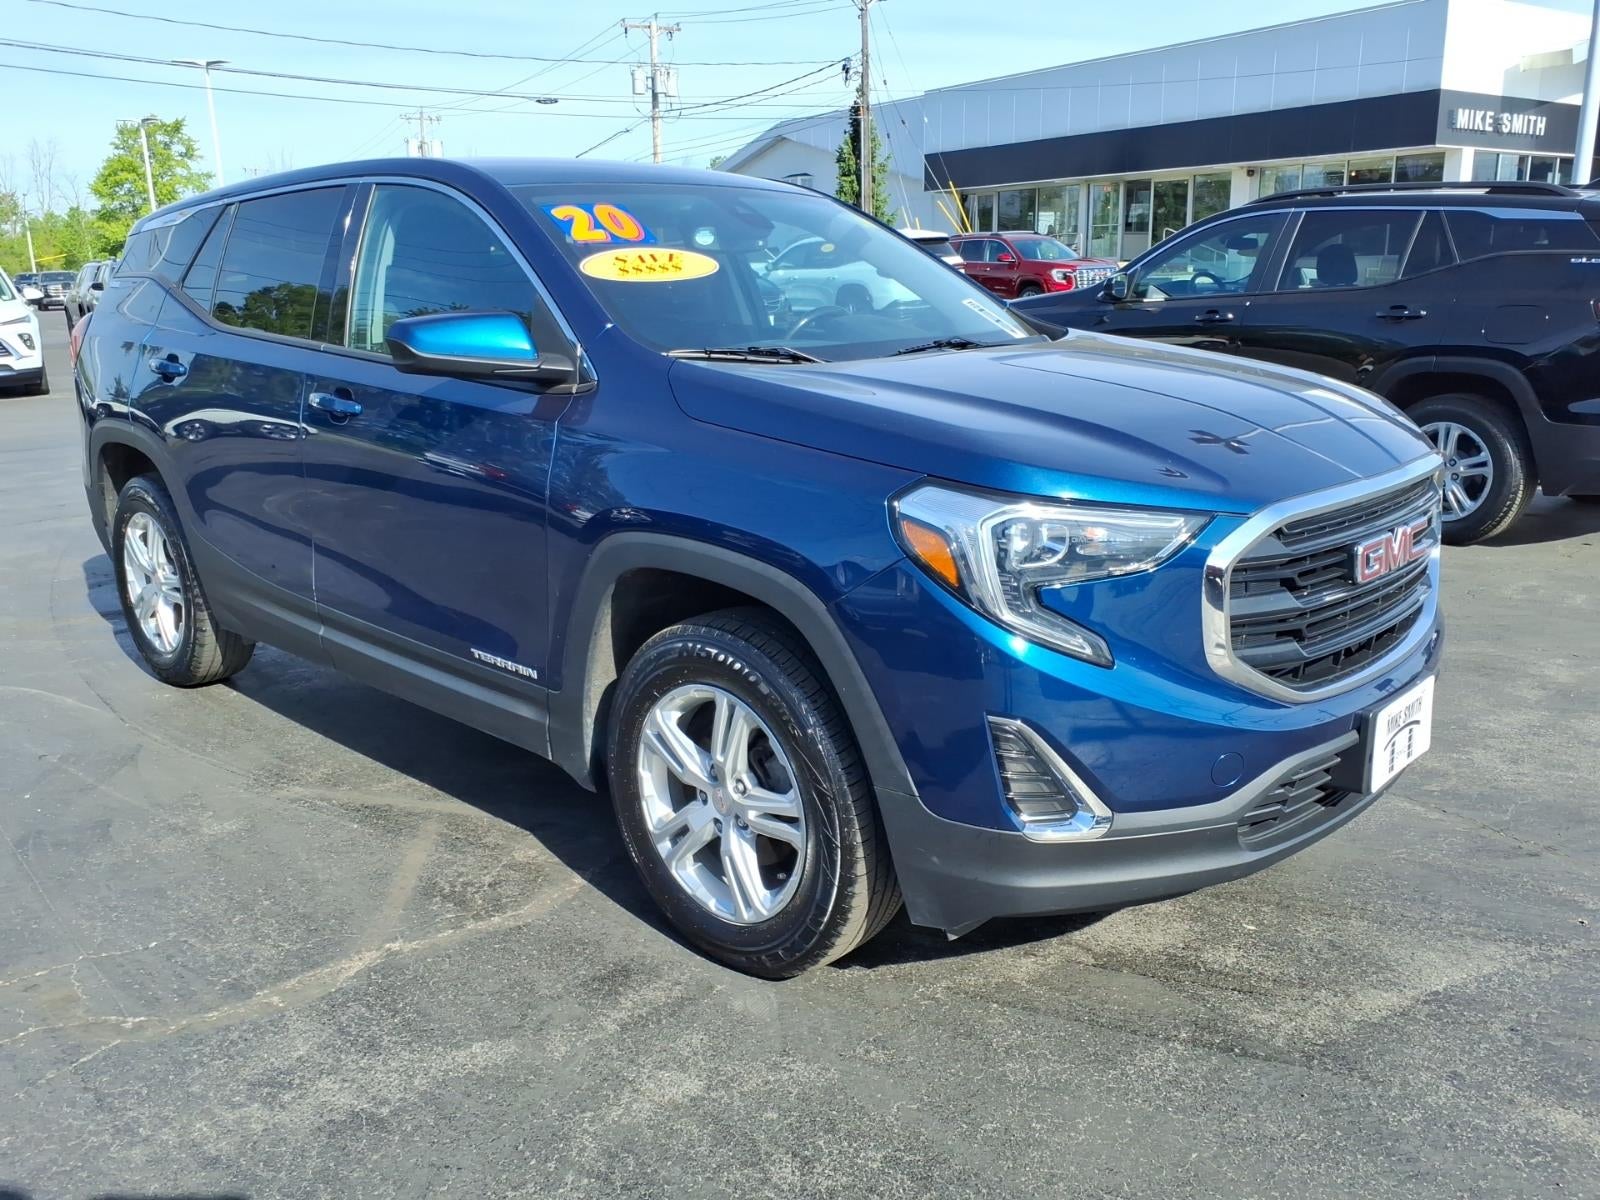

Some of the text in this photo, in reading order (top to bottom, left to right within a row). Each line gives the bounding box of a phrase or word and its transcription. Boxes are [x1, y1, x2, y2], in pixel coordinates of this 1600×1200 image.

[1456, 108, 1547, 136] MIKE SMITH
[550, 203, 645, 242] 20
[1354, 516, 1429, 584] GMC
[470, 647, 538, 680] TERRAIN
